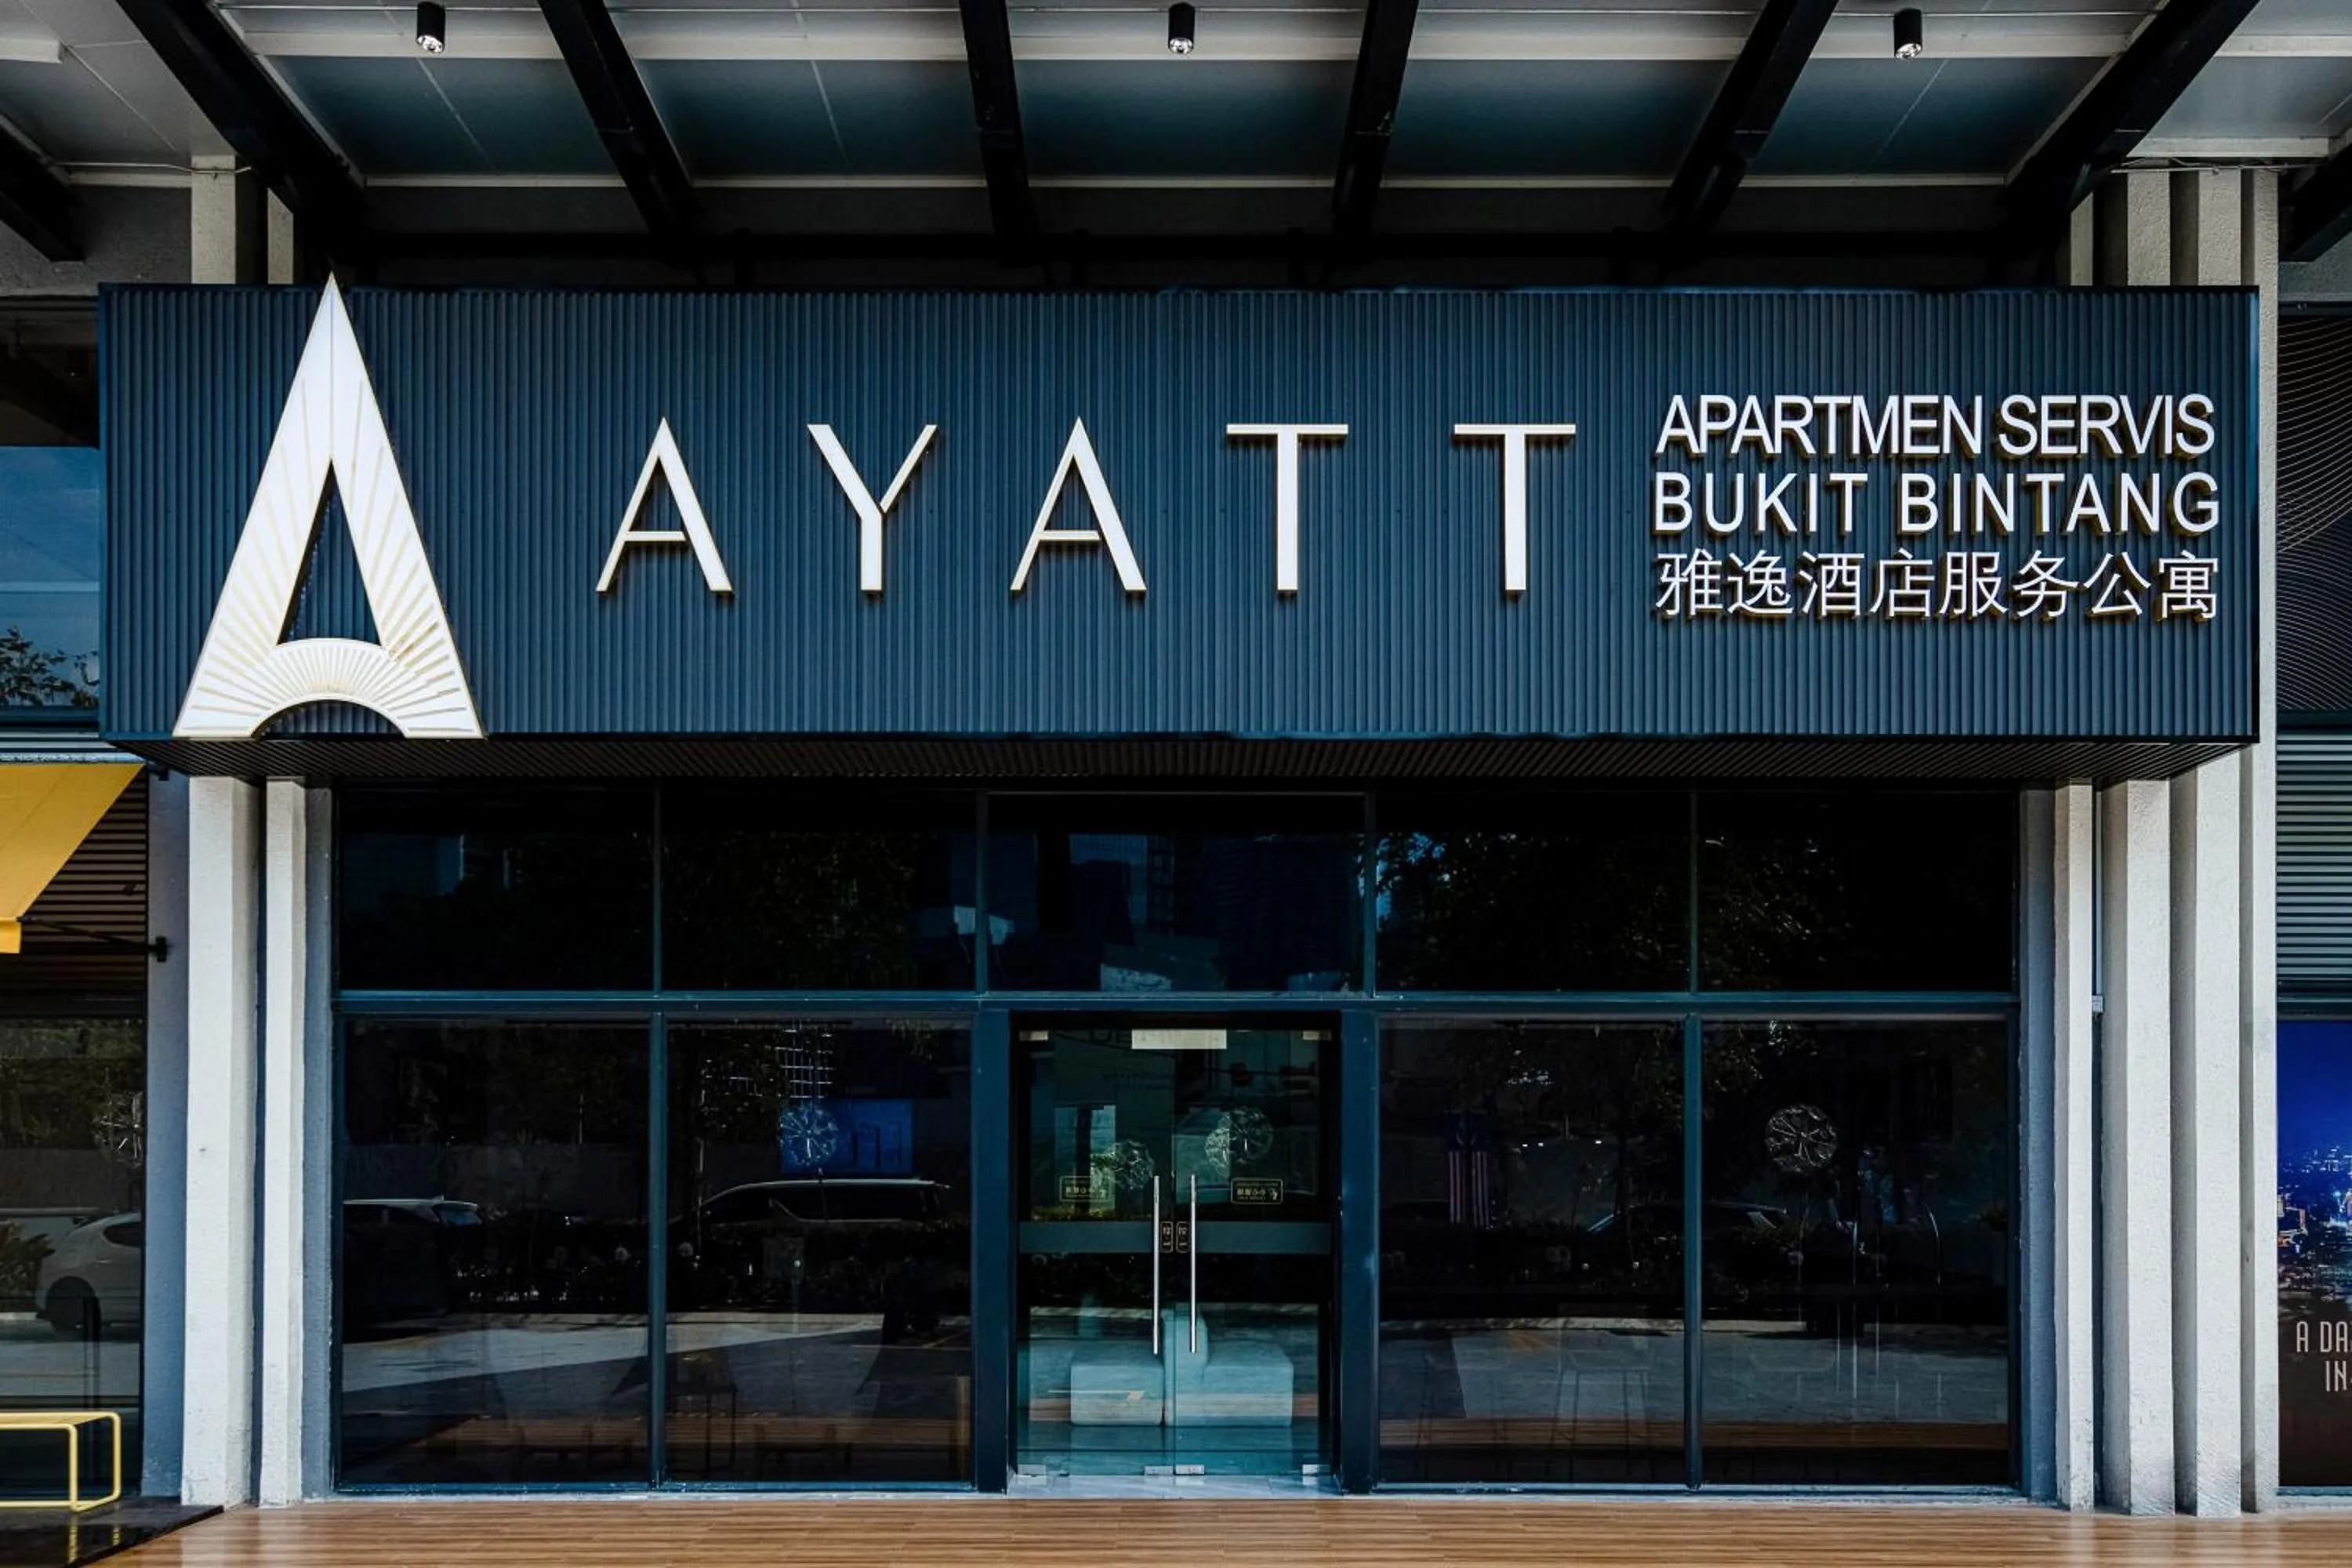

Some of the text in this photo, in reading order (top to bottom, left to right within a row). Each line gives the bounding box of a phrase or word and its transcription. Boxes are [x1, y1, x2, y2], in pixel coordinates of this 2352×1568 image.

[1656, 394, 2216, 456] APARTMEN SERVIS
[172, 271, 484, 739] A
[596, 416, 1577, 593] AYATT
[1655, 472, 2219, 534] BUKIT BINTANG
[1655, 548, 2218, 619] 雅逸酒店服务公寓
[2296, 1320, 2352, 1353] A DA
[2325, 1360, 2352, 1392] IN
